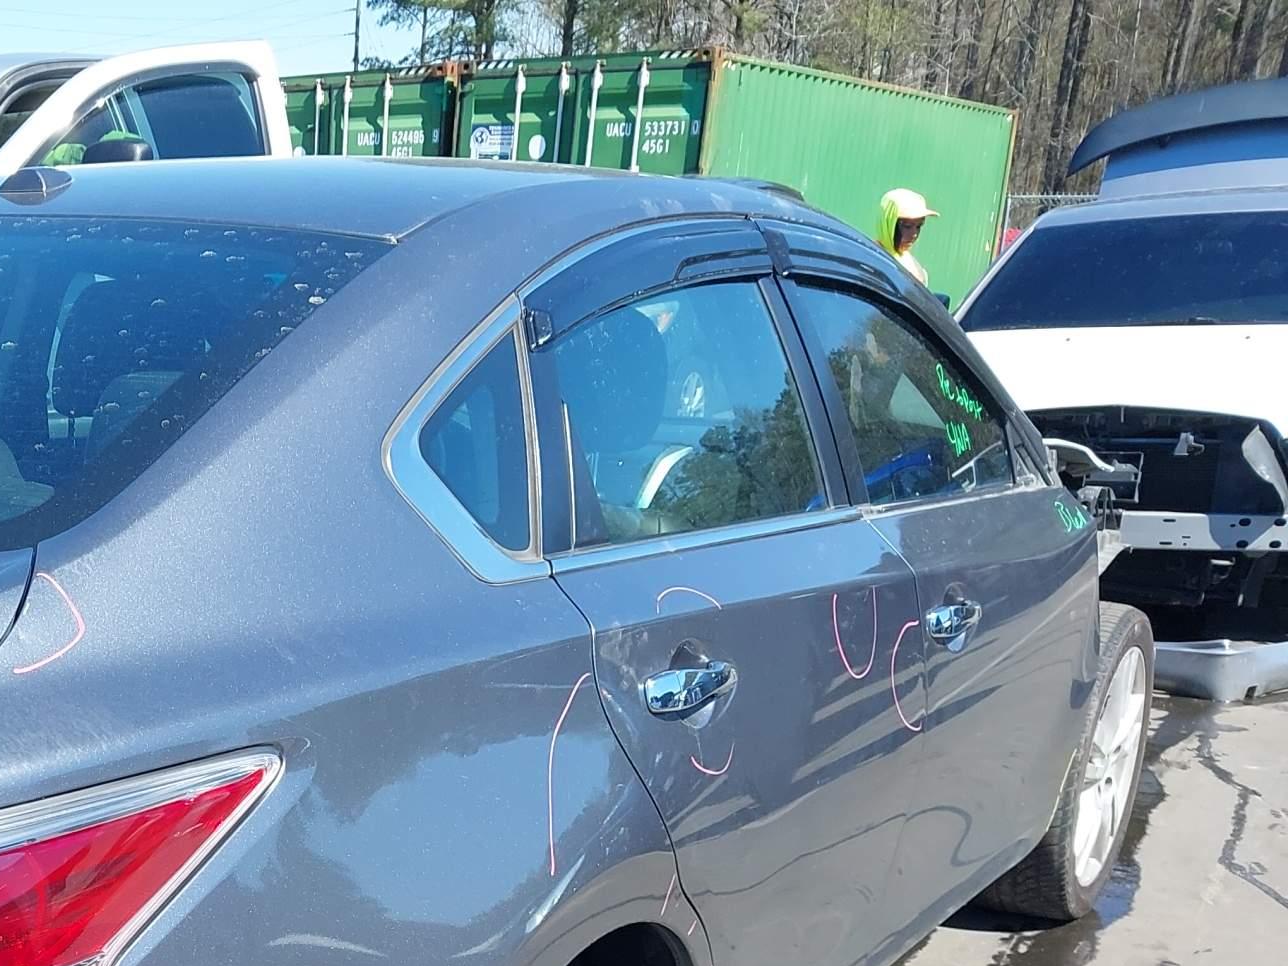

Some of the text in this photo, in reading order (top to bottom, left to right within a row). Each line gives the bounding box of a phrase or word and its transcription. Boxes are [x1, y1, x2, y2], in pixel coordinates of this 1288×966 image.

[357, 128, 440, 146] UACU 524495 9
[606, 122, 632, 137] UACU
[644, 120, 686, 136] 533731
[641, 138, 670, 154] 45G1
